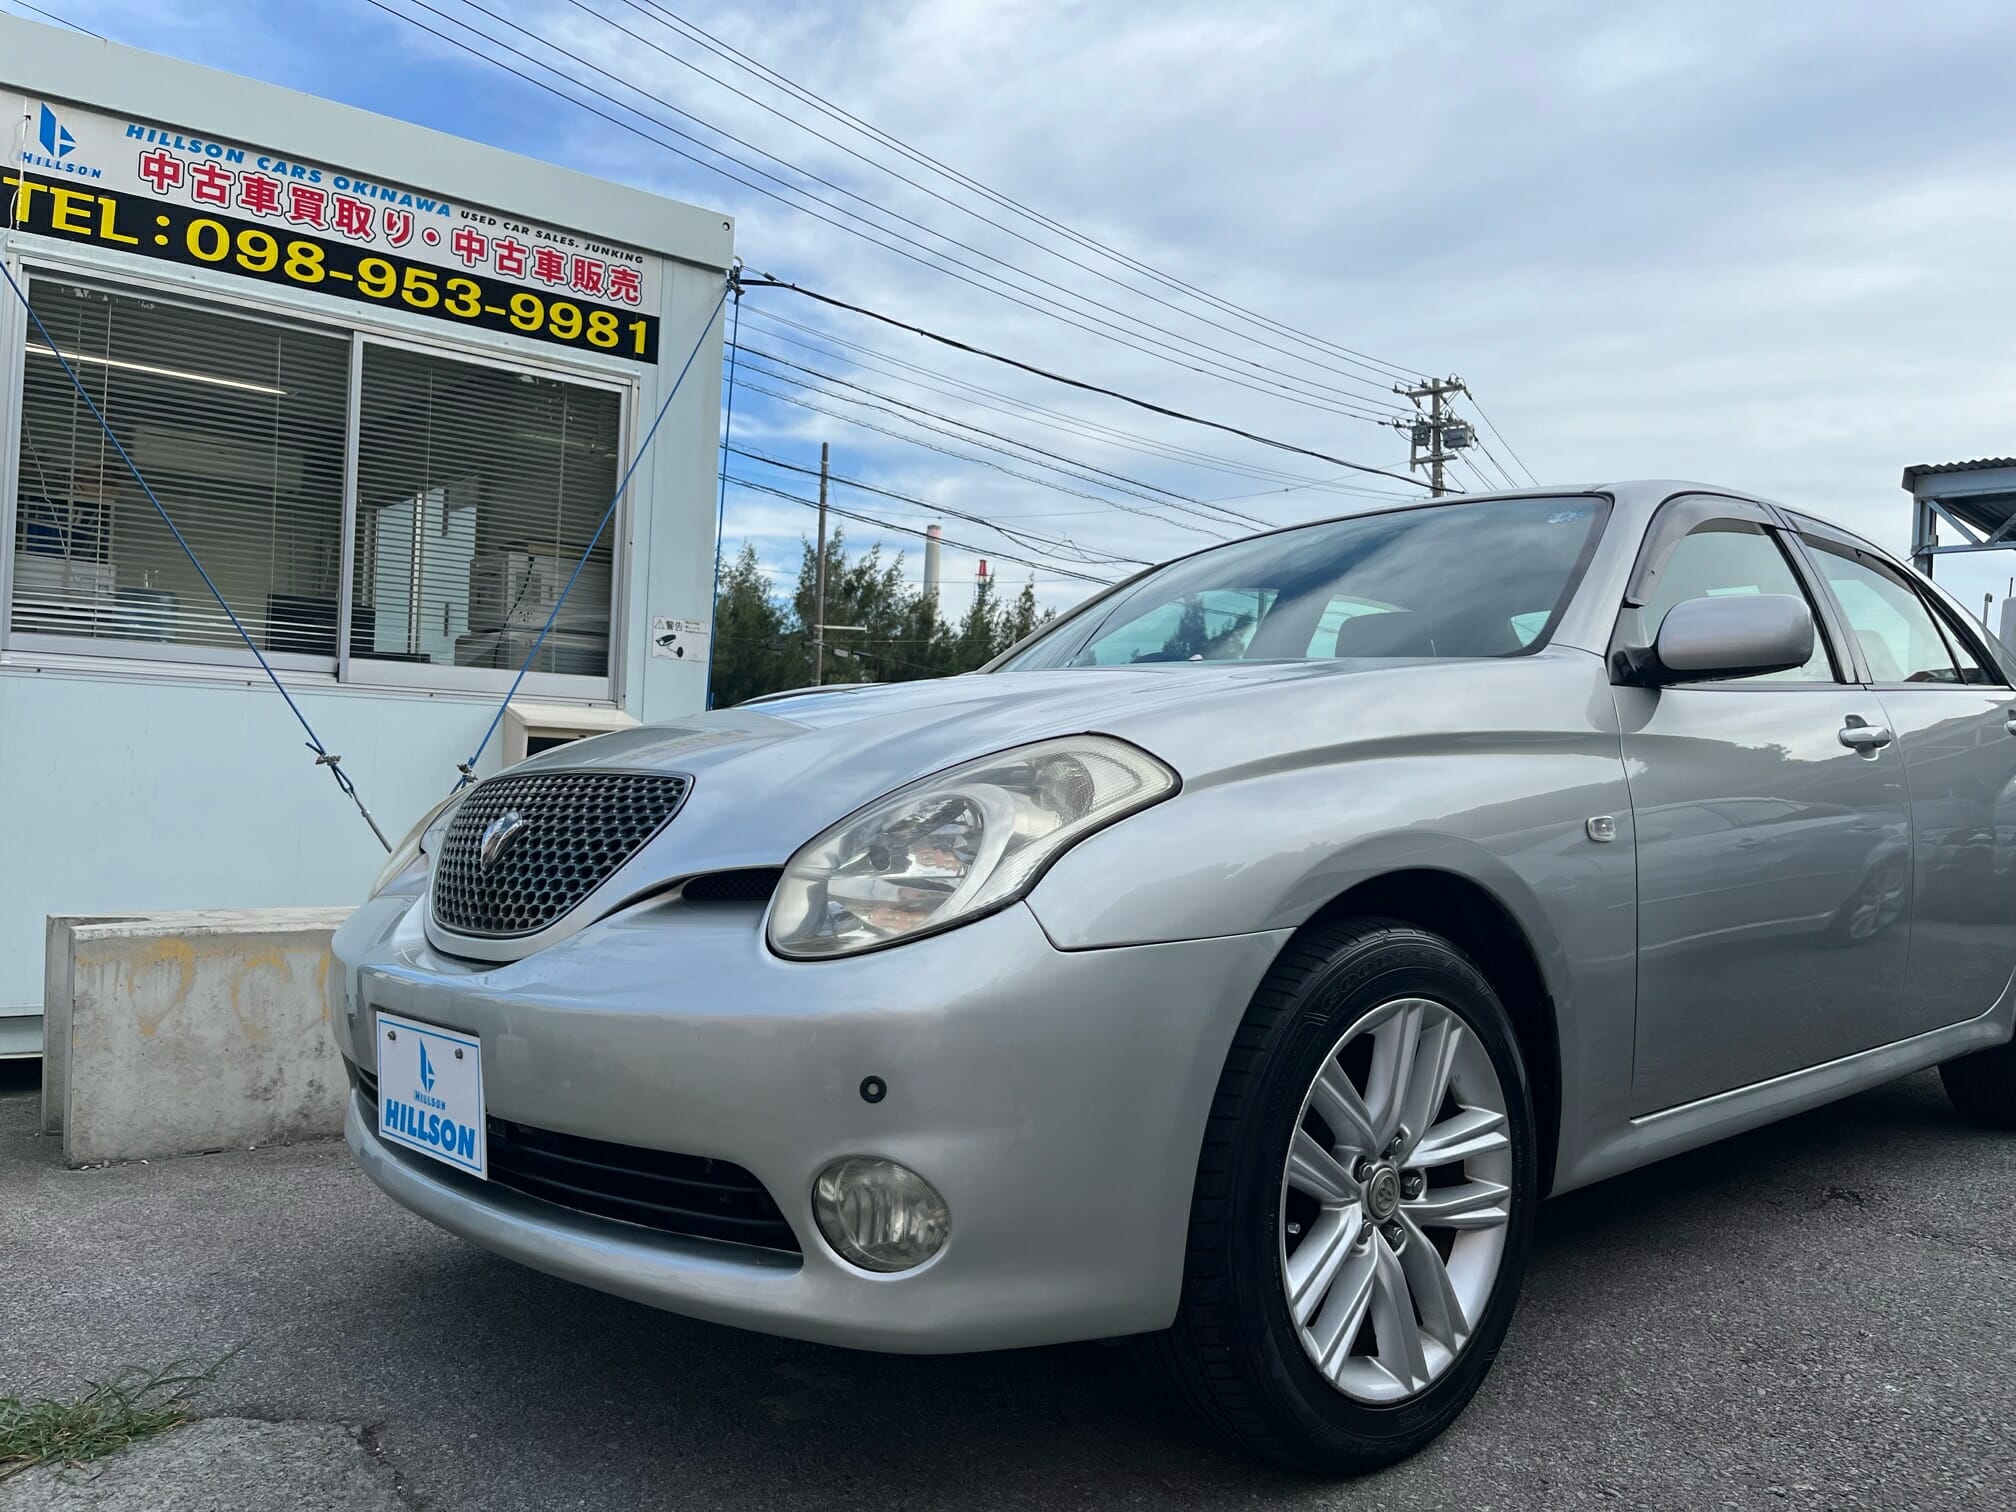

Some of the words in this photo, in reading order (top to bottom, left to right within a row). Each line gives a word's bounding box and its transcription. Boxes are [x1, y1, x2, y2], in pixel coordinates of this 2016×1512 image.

[22, 151, 101, 178] HILLSON
[125, 124, 245, 164] HILLSON
[257, 156, 322, 184] CARS
[333, 176, 451, 218] OKINAWA
[460, 210, 497, 226] USED
[503, 222, 530, 235] CAR
[584, 243, 644, 264] JUNKING
[142, 152, 643, 304] 中古車買取り・中古車販売
[386, 1099, 475, 1159] HILLSON
[415, 1091, 445, 1110] HILLSON
